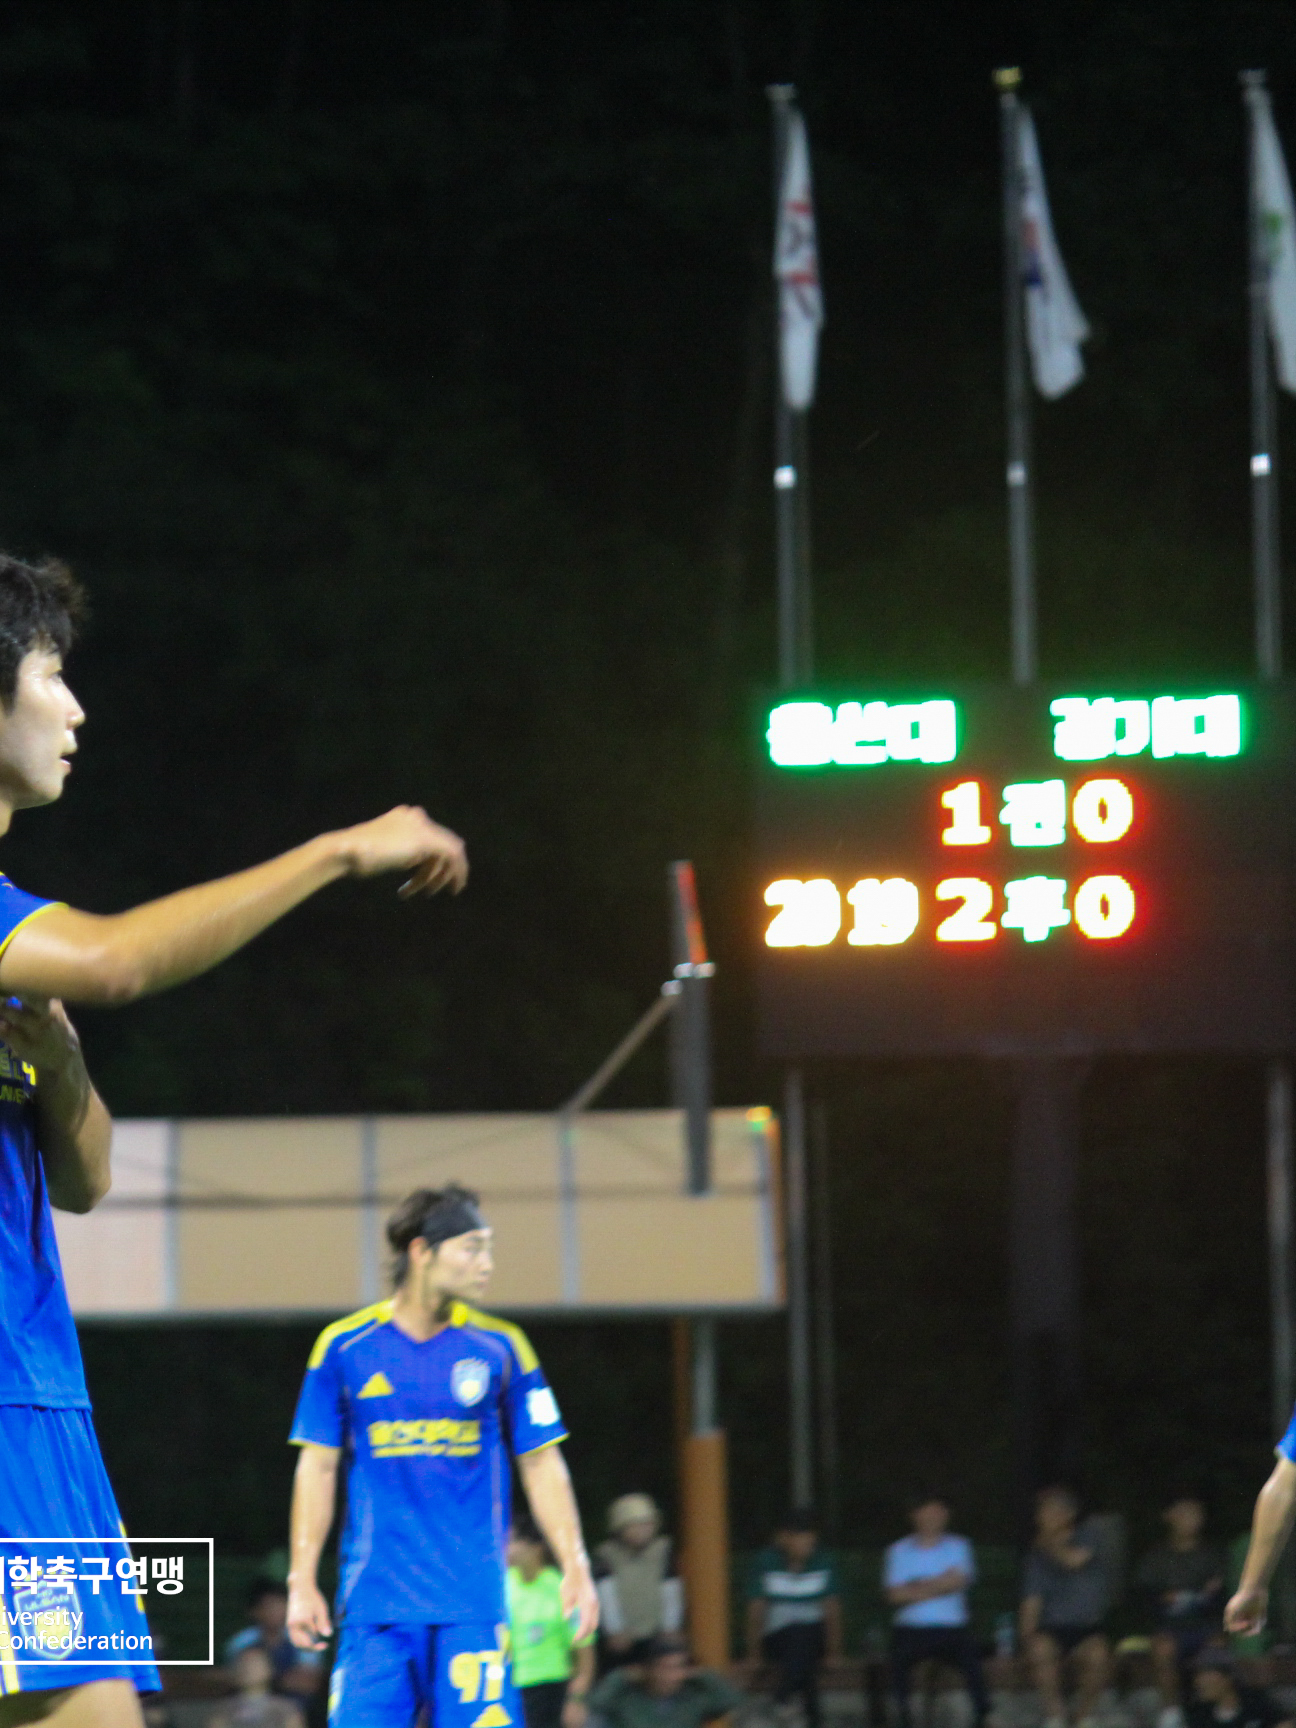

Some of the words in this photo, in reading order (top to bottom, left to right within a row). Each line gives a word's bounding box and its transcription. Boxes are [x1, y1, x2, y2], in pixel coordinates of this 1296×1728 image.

[943, 782, 990, 845] 1
[1073, 779, 1133, 843] 0
[936, 877, 996, 941] 2
[1074, 875, 1135, 939] 0
